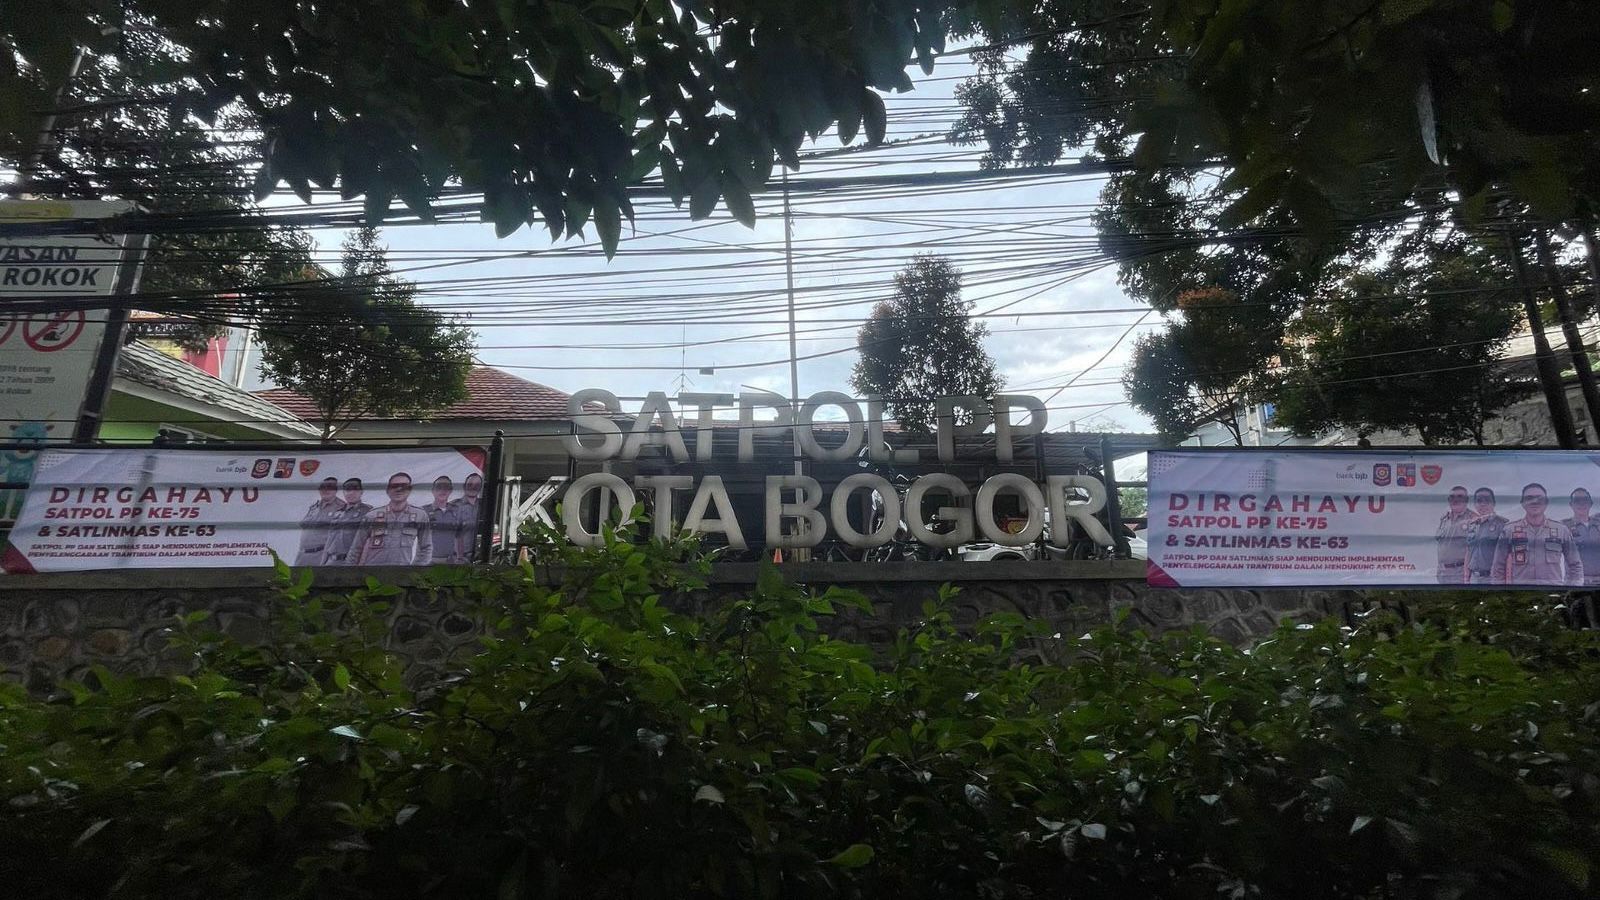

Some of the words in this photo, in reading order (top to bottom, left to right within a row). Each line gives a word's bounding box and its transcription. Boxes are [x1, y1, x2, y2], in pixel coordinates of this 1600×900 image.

[0, 247, 78, 262] ASAN
[3, 267, 99, 286] ROKOK
[562, 388, 920, 465] SATPOL
[936, 392, 1050, 463] PP
[1335, 472, 1354, 480] bank
[1355, 472, 1368, 480] bjb
[49, 486, 260, 504] DIRGAHAYU
[499, 471, 748, 551] KOTA
[766, 471, 1117, 550] BOGOR
[1169, 493, 1386, 514] DIRGAHAYU
[44, 507, 115, 519] SATPOL
[119, 507, 143, 519] PP
[147, 507, 200, 519] KE-75
[1167, 515, 1242, 529] SATPOL
[1246, 516, 1272, 529] PP
[1276, 517, 1328, 530] KE-75
[38, 525, 51, 537] &
[56, 525, 160, 538] SATLINMAS
[165, 524, 216, 537] KE-63
[1165, 535, 1179, 547] &
[1184, 535, 1292, 549] SATLINMAS
[1297, 536, 1349, 549] KE-63
